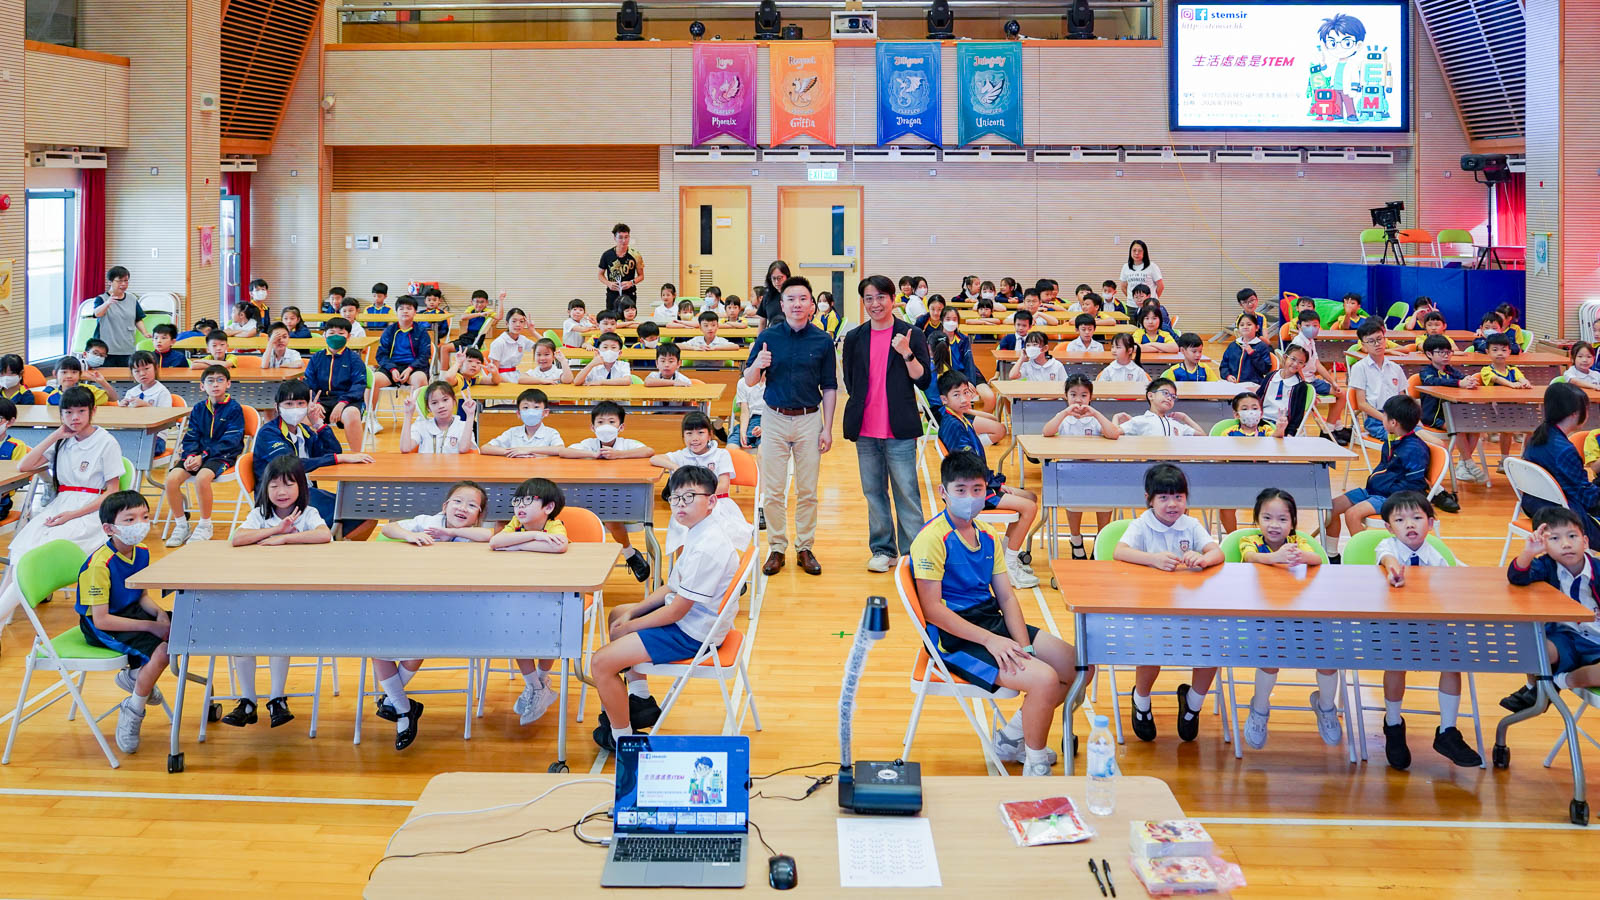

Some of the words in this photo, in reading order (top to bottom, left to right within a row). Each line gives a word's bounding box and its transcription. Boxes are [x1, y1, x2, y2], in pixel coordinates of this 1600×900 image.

[1211, 11, 1247, 19] stemsir
[1192, 54, 1295, 67] 生活處處是STEM
[1319, 103, 1329, 113] T
[1363, 97, 1379, 109] M
[712, 117, 737, 128] Phoenix
[790, 117, 816, 128] Griffin
[896, 117, 922, 127] Dragon
[976, 117, 1005, 127] Unicorn
